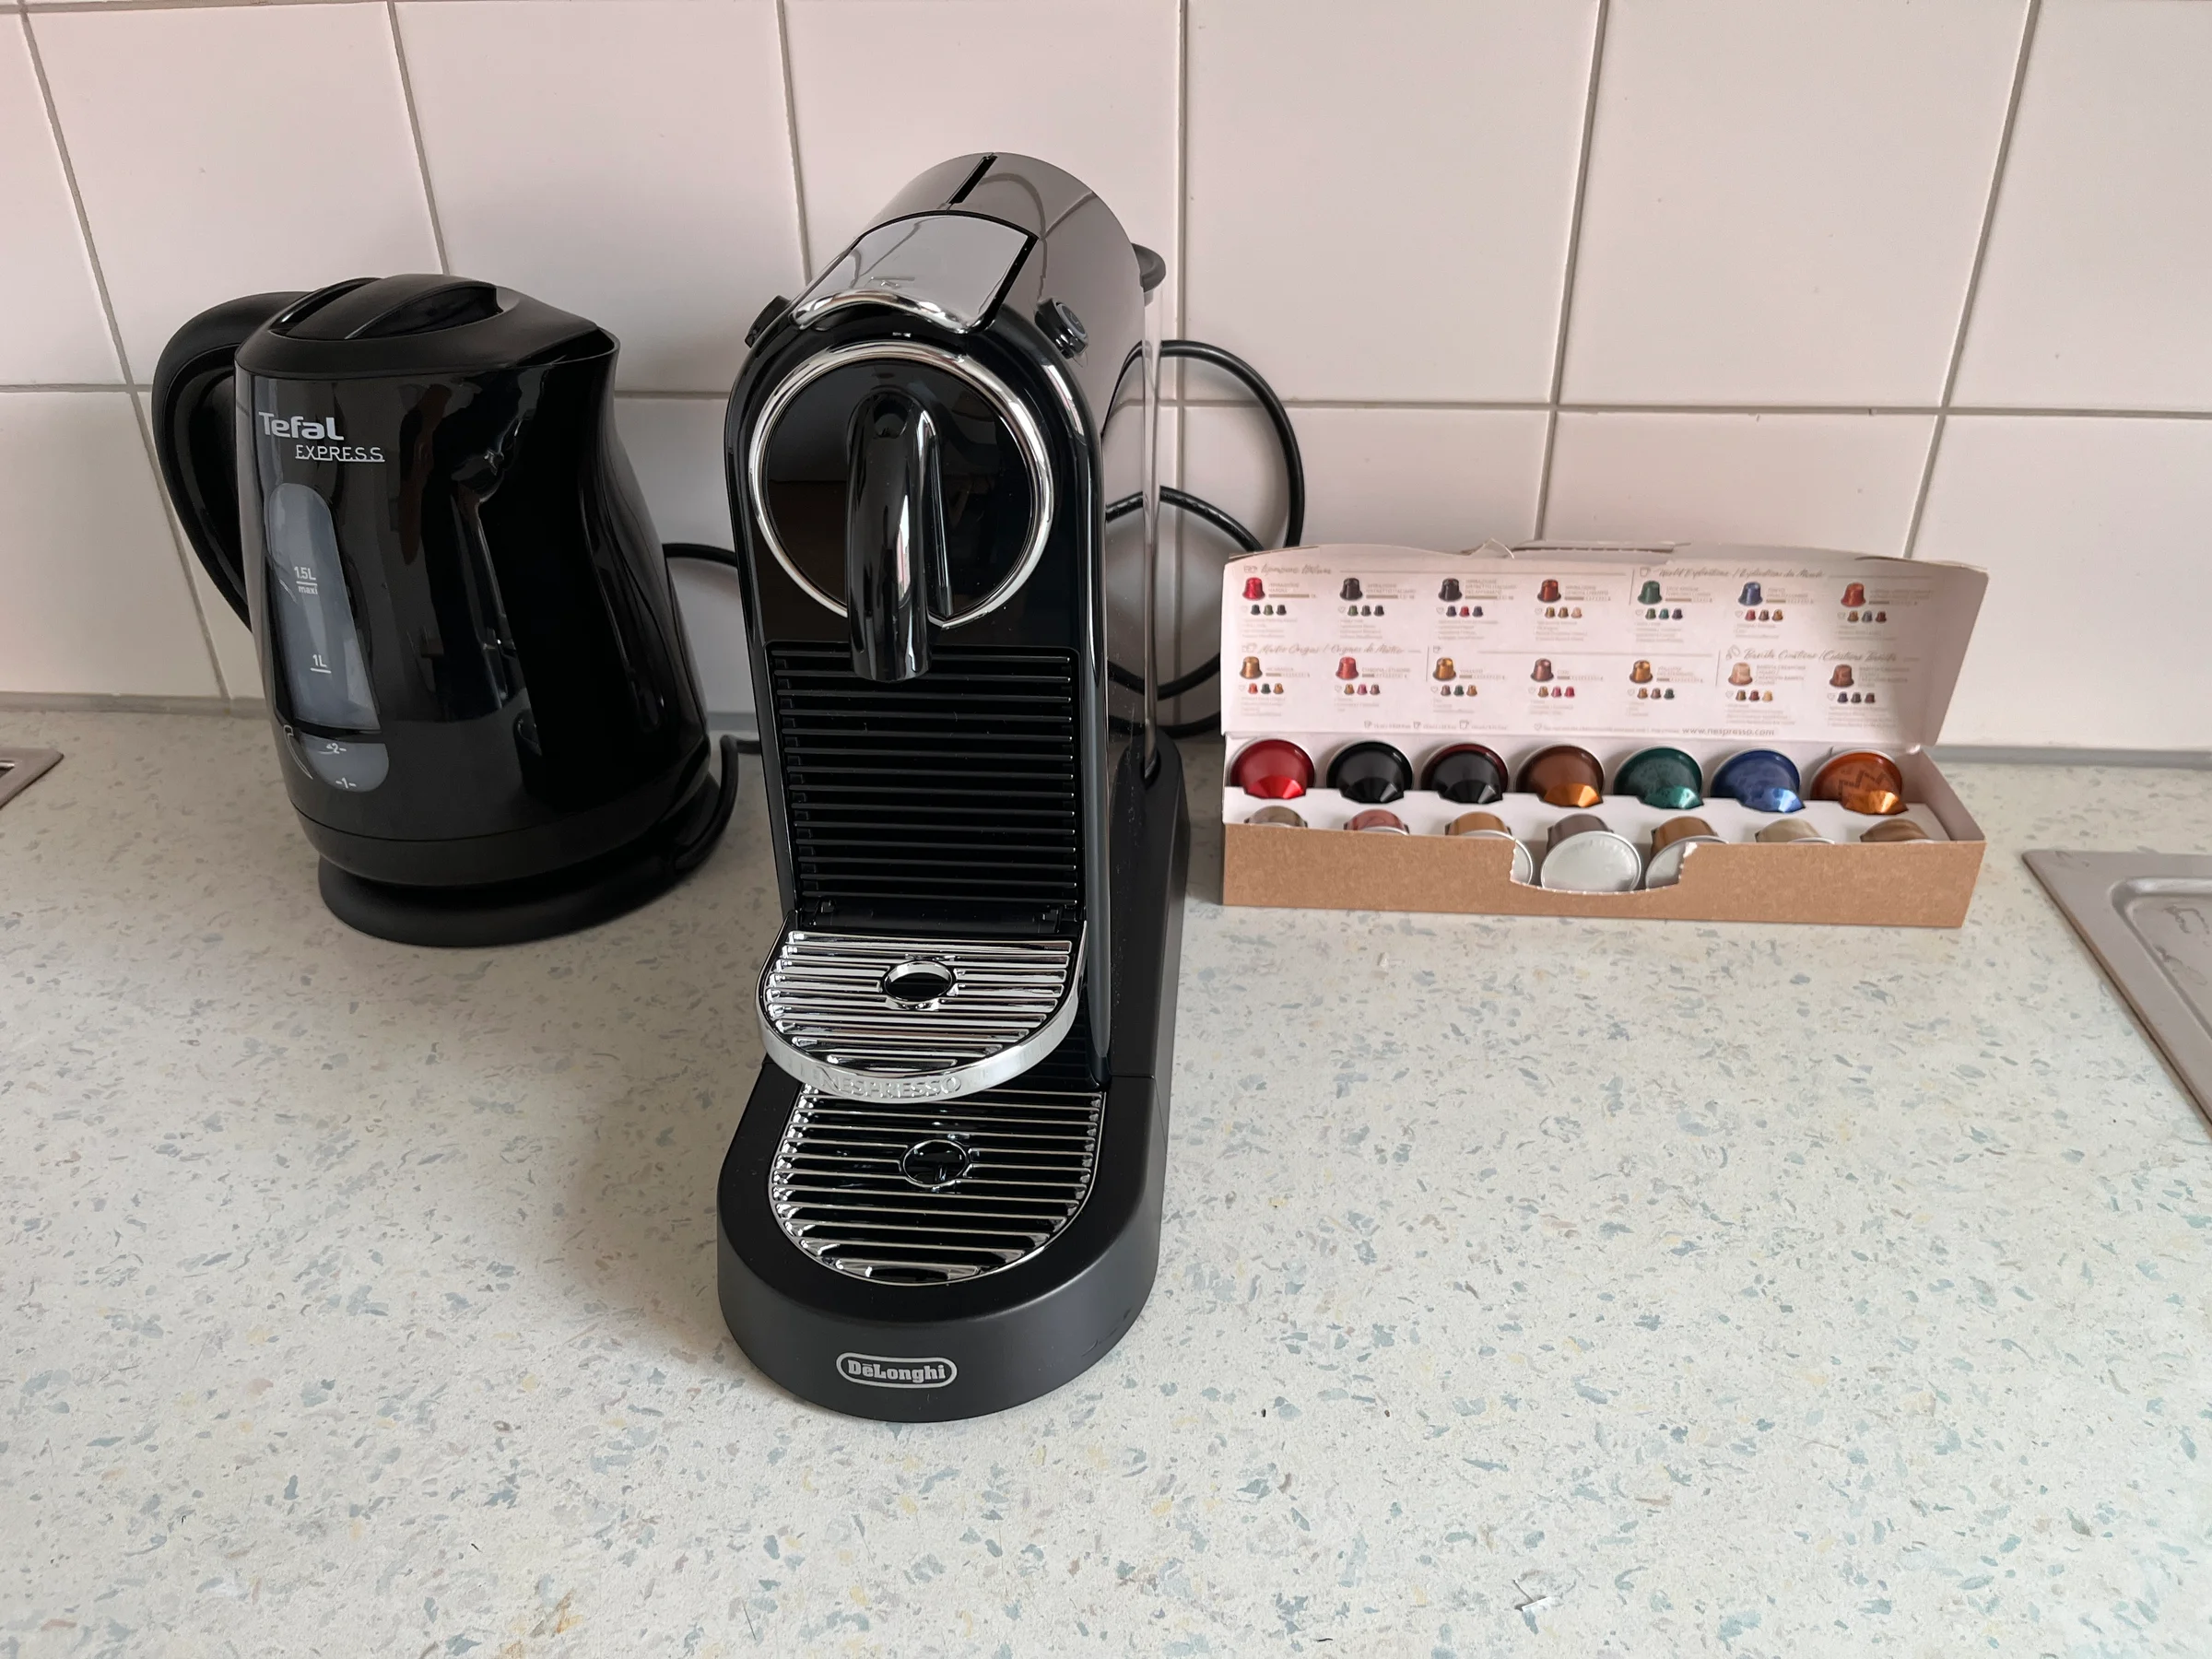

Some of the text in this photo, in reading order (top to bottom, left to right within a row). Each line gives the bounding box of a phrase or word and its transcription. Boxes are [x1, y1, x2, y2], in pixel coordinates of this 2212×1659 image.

[258, 411, 345, 441] Tefal
[295, 444, 385, 463] EXPRESS
[298, 585, 318, 595] maxi
[312, 653, 327, 668] 1L
[1681, 727, 1774, 737] www.nespresso.com
[817, 1065, 962, 1099] NESPRESSO
